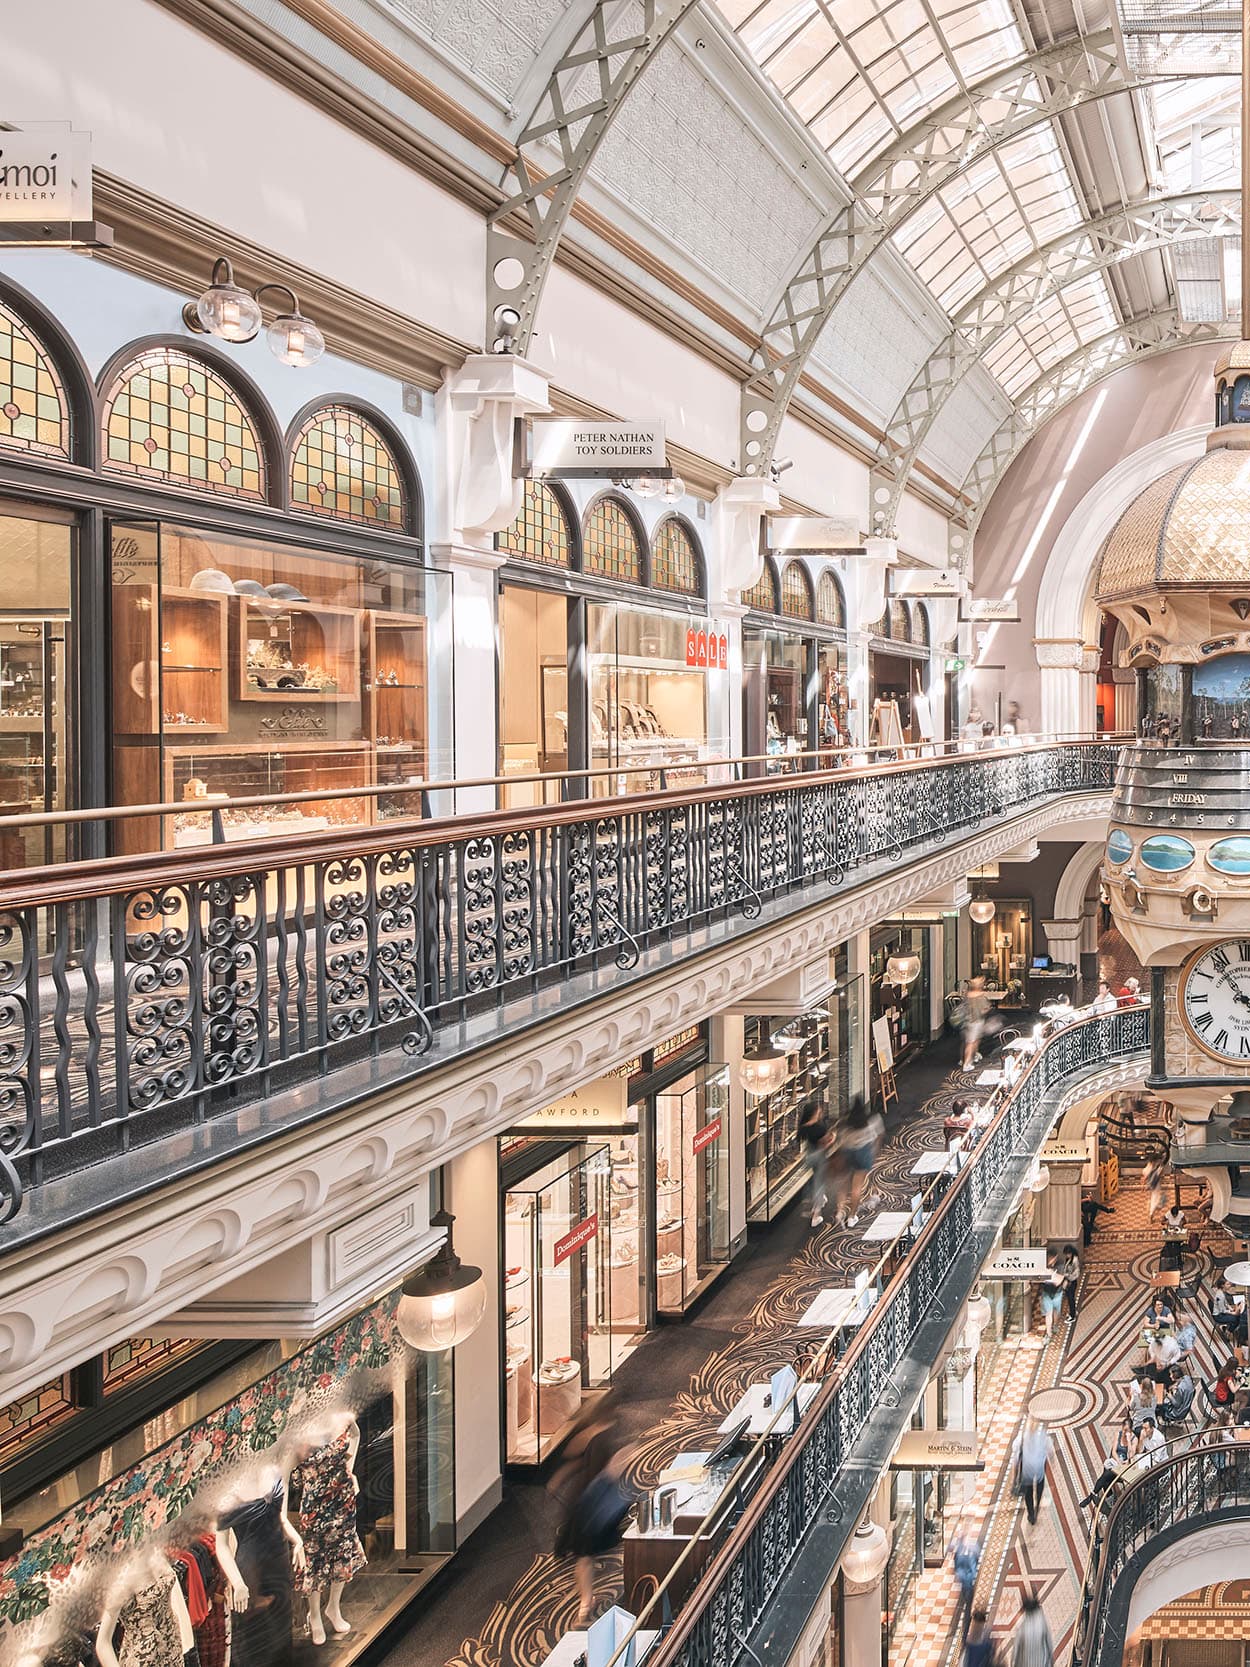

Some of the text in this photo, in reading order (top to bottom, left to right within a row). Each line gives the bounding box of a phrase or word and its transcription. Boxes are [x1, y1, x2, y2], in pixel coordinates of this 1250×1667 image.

[574, 433, 654, 442] PETER NATHAN
[576, 446, 652, 455] TOY SOLDIERS
[688, 641, 726, 661] SALE
[1172, 793, 1208, 804] FRIDAY
[1147, 812, 1154, 821] 3
[1170, 814, 1176, 823] 4
[1198, 814, 1204, 824] 5
[1228, 815, 1234, 825] 6
[1239, 944, 1250, 962] XII
[557, 1222, 596, 1257] Dominique's
